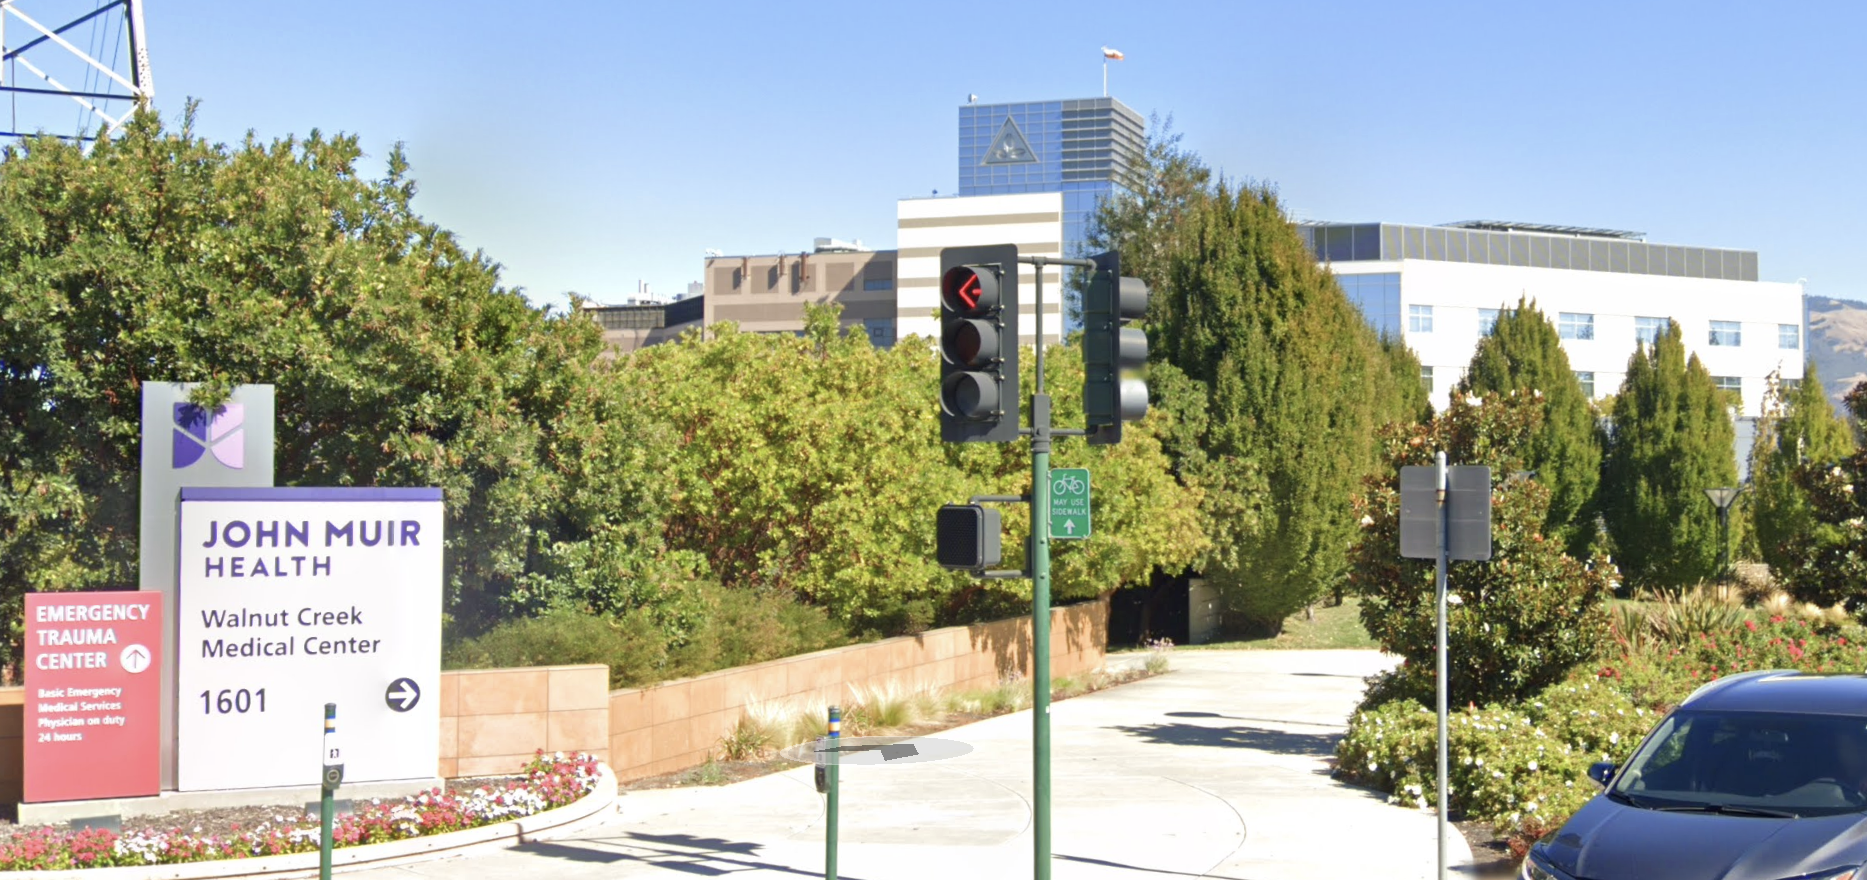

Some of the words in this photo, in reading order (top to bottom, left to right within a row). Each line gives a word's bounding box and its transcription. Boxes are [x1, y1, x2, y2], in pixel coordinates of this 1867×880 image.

[1053, 498, 1067, 506] MAY
[1071, 498, 1084, 506] USE
[1052, 508, 1086, 516] SIDEWALK
[202, 520, 309, 548] JOHN
[325, 520, 421, 547] MUIR
[205, 556, 331, 577] HEALTH
[36, 604, 150, 622] EMERGENCY
[201, 608, 289, 628] Walnut
[297, 606, 363, 626] Creek
[36, 628, 117, 646] TRAUMA
[202, 636, 294, 658] Medical
[304, 637, 381, 655] Center
[36, 652, 107, 670] CENTER
[38, 688, 65, 698] Basic
[67, 687, 122, 699] Emergency
[200, 688, 265, 714] 1601
[38, 702, 78, 713] Medical
[80, 701, 121, 712] Services
[38, 717, 84, 729] Physician
[87, 718, 100, 726] on
[103, 715, 125, 727] duty
[38, 732, 51, 743] 24
[53, 732, 82, 742] hours
